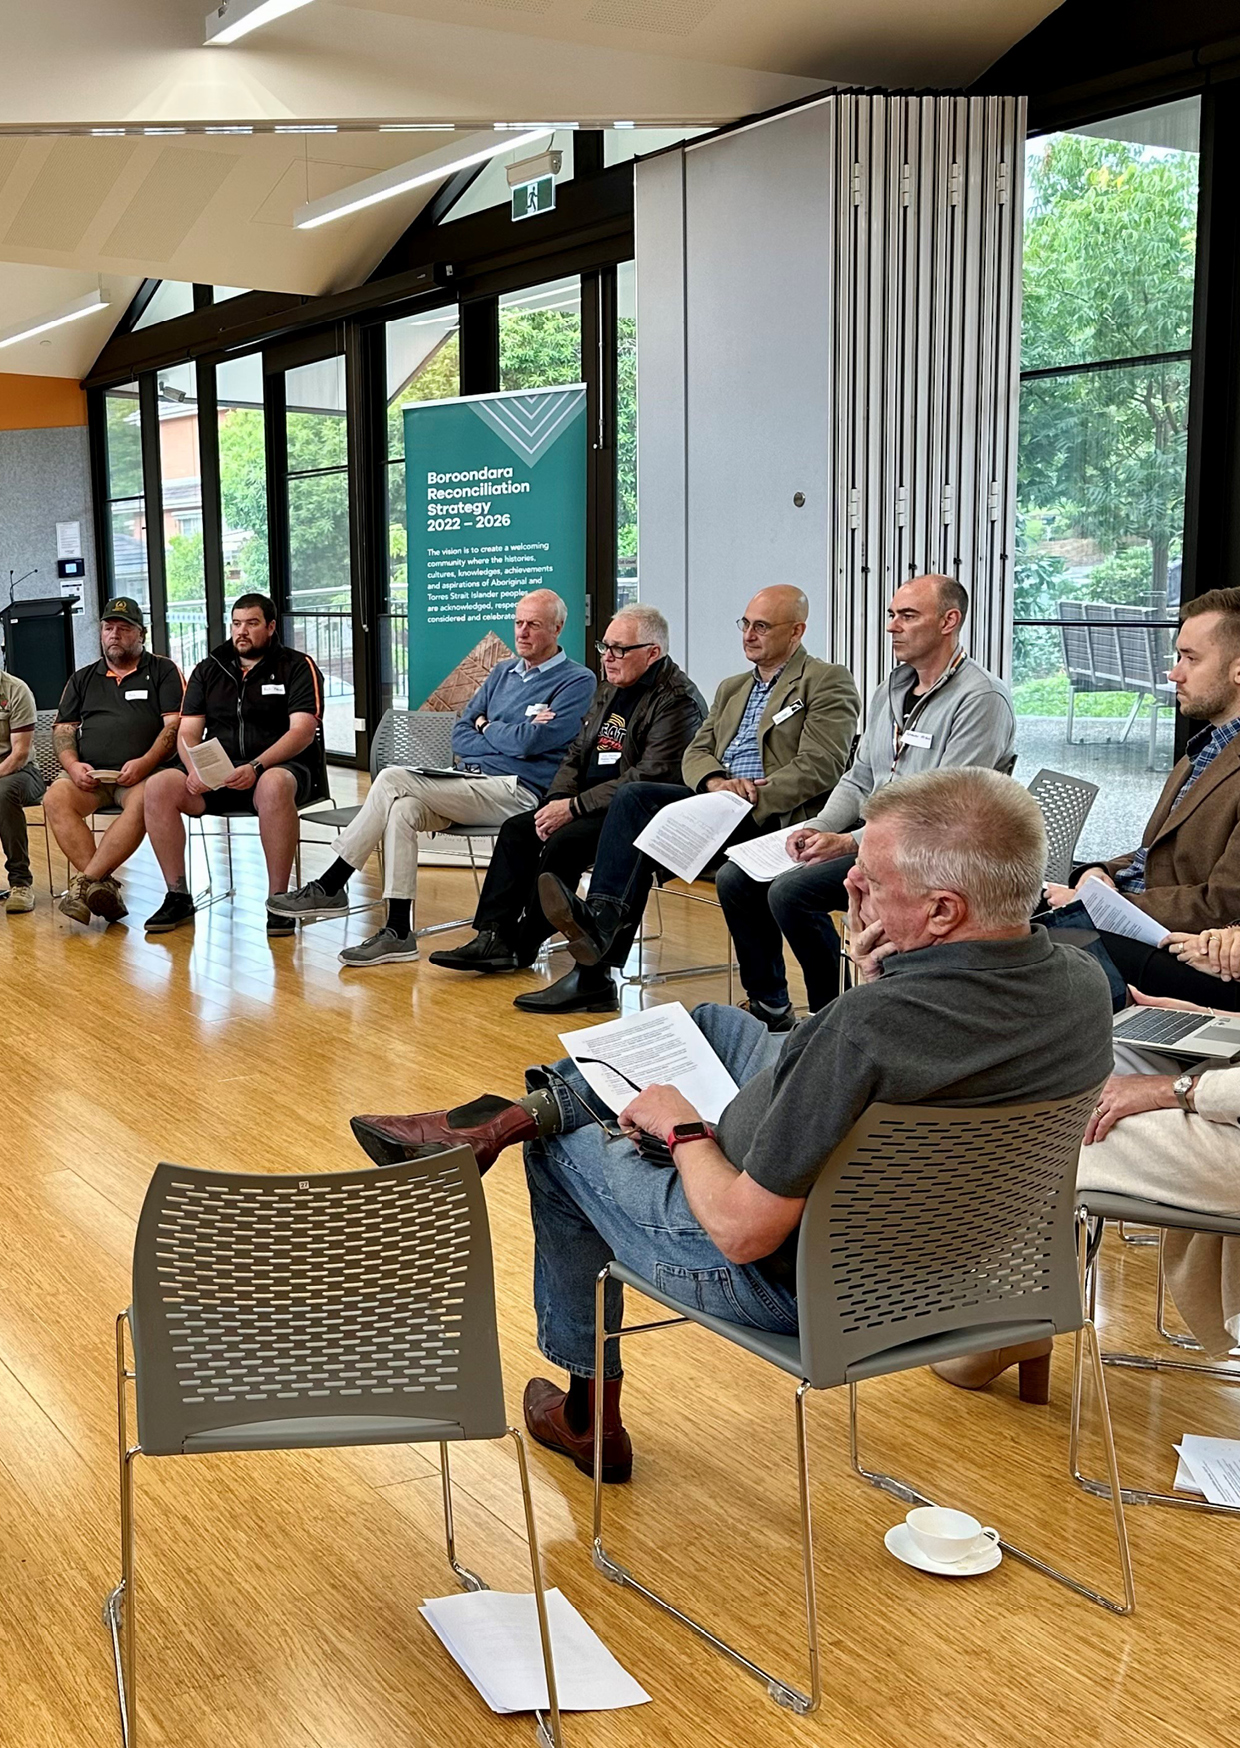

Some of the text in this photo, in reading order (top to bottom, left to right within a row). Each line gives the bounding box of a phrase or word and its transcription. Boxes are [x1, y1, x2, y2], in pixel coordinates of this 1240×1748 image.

[427, 466, 513, 484] Boroondara
[427, 480, 530, 500] Reconciliation
[427, 501, 492, 516] Strategy
[427, 517, 461, 532] 2022
[475, 514, 511, 529] 2026
[427, 548, 441, 557] The
[442, 547, 462, 555] vision
[463, 546, 470, 554] is
[471, 546, 479, 554] to
[480, 545, 503, 553] create
[510, 542, 550, 552] welcoming
[427, 559, 466, 568] community
[467, 557, 490, 565] where
[427, 565, 553, 579] cultures, knowledges, achievements
[427, 576, 543, 590] and aspirations of Aboriginal and
[427, 593, 449, 601] Torres
[471, 590, 498, 599] Islander
[440, 601, 494, 612] acknowledged,
[427, 614, 466, 623] considered
[467, 612, 481, 621] and
